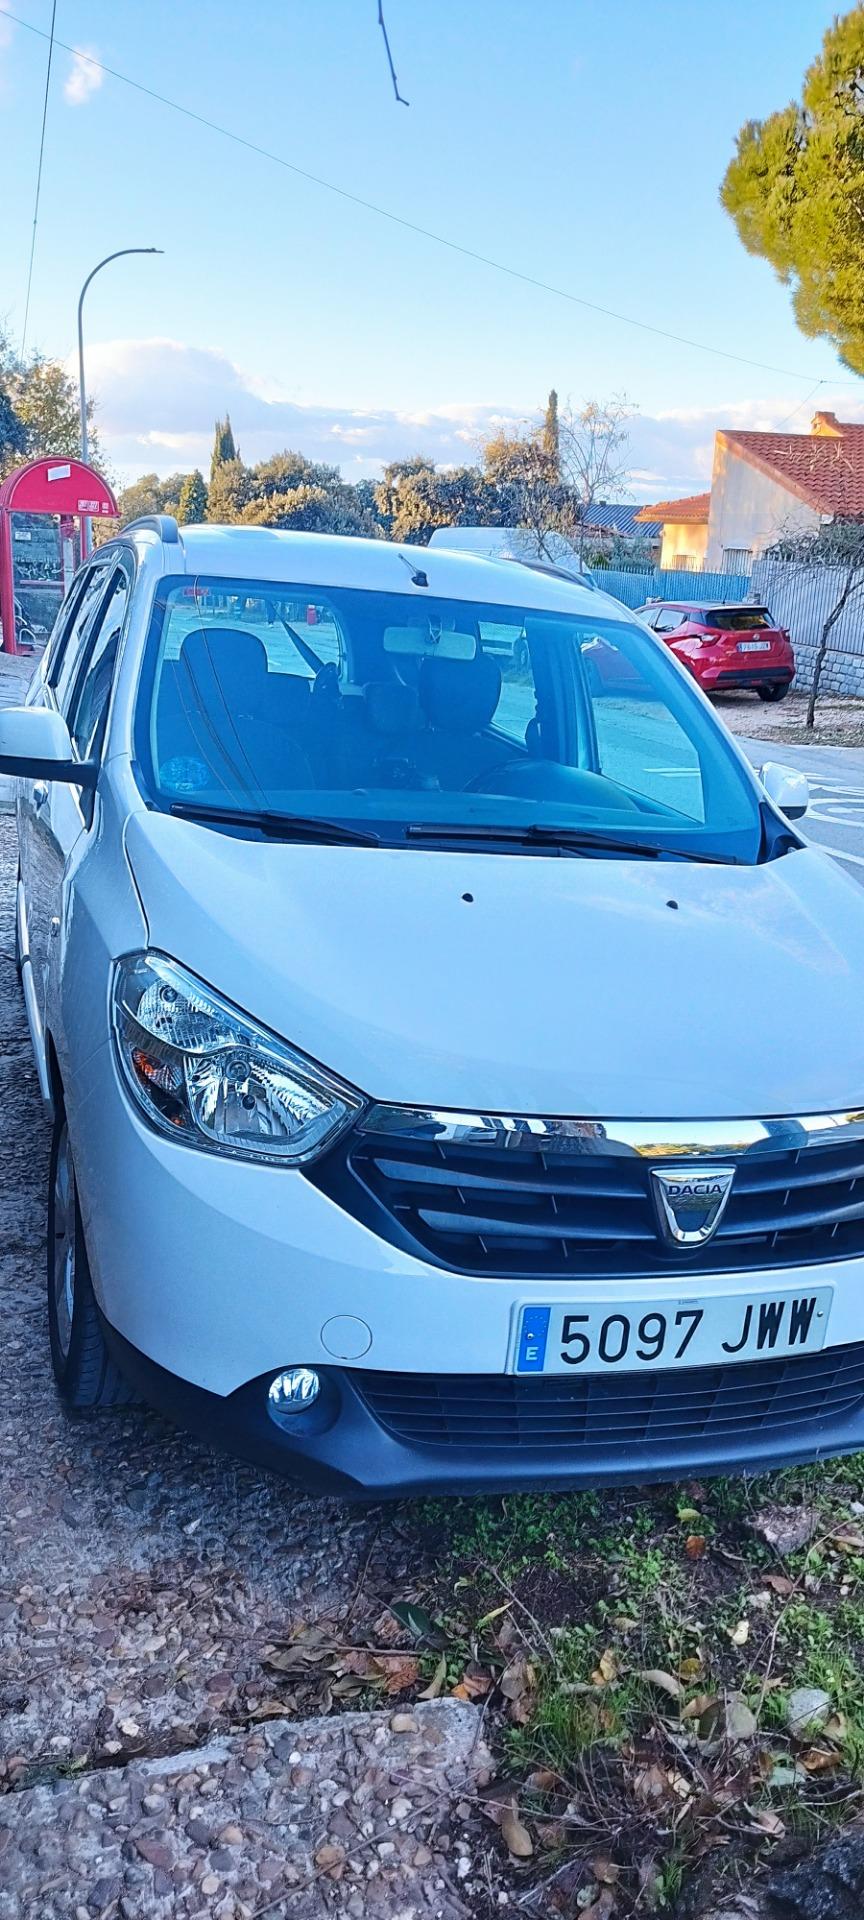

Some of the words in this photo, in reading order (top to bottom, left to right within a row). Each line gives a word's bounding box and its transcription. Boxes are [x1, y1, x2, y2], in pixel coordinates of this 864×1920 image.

[668, 1184, 722, 1195] DACIA
[525, 1346, 539, 1361] E
[560, 1308, 704, 1365] 5097
[721, 1297, 817, 1353] JWW
